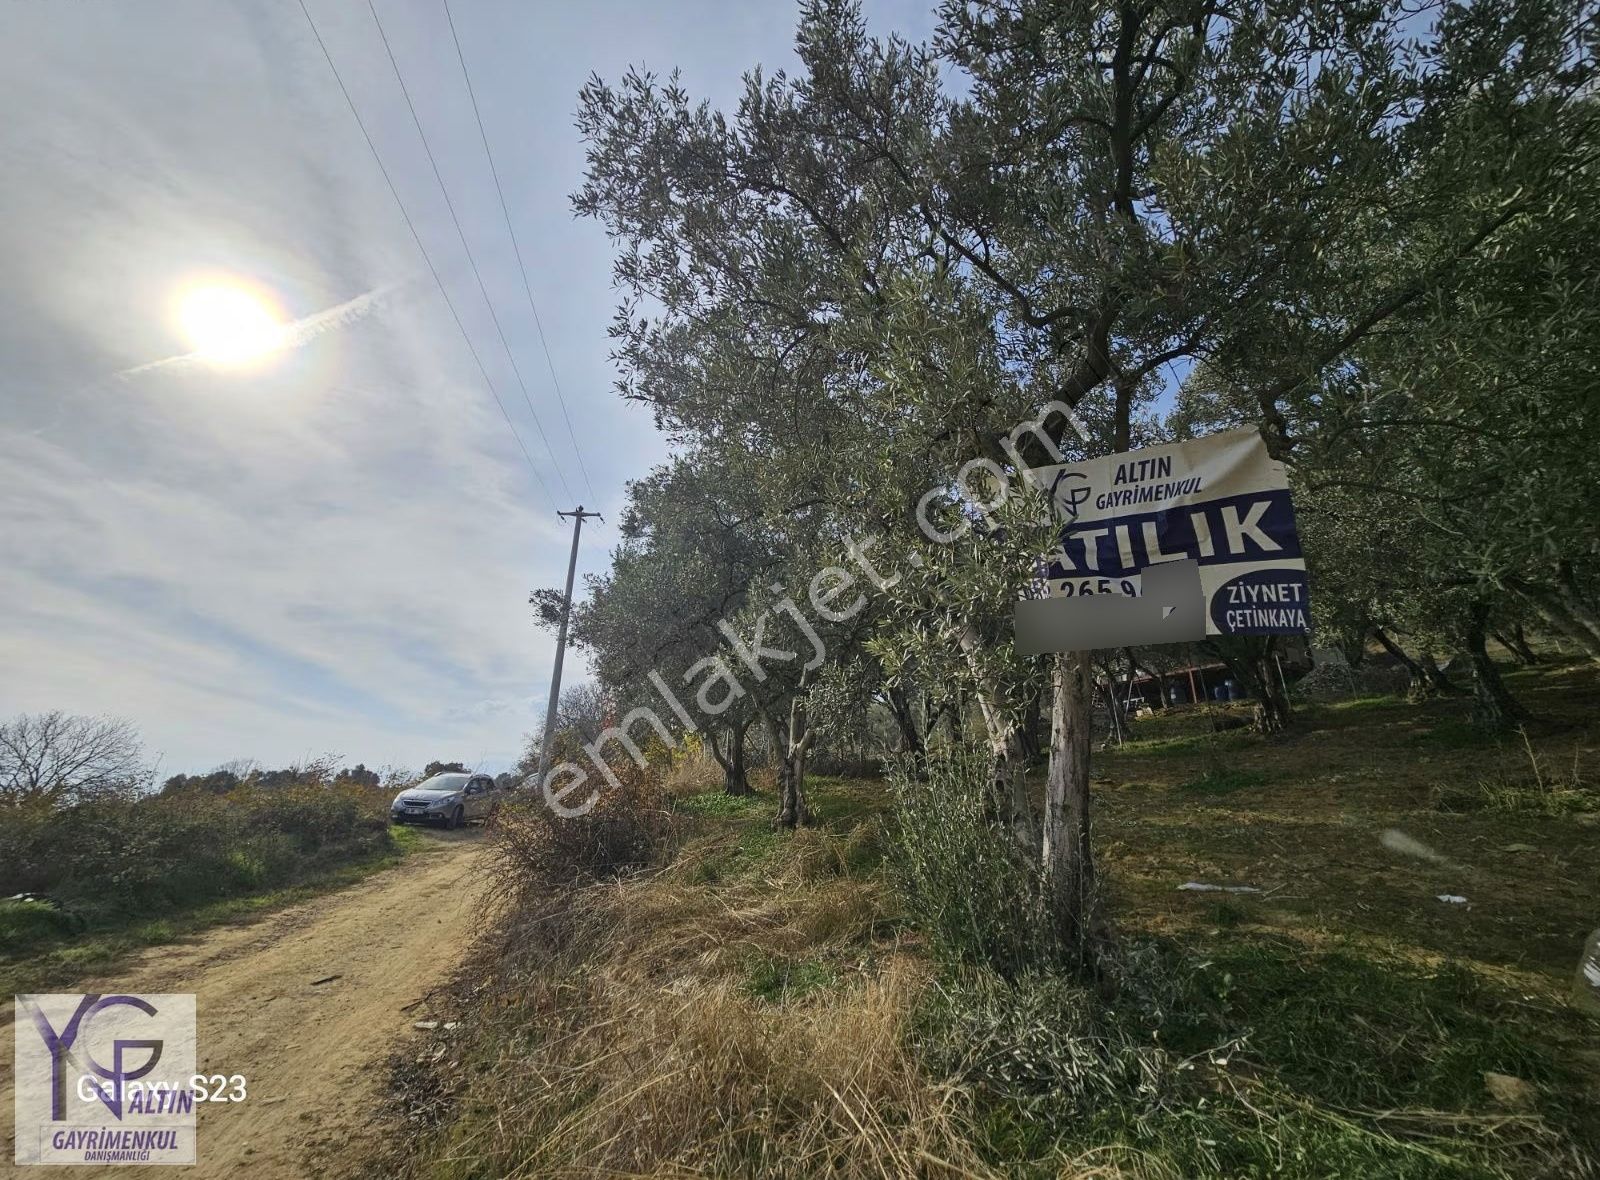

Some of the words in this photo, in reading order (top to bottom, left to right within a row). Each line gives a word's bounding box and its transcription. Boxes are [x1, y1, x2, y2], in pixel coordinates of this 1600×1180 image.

[1114, 456, 1172, 486] ALTIN
[1095, 477, 1203, 510] GAYRİMENKUL
[1040, 500, 1284, 571] ATILIK
[1227, 581, 1303, 604] ZİYNET
[1226, 605, 1307, 632] ÇETİNKAYA
